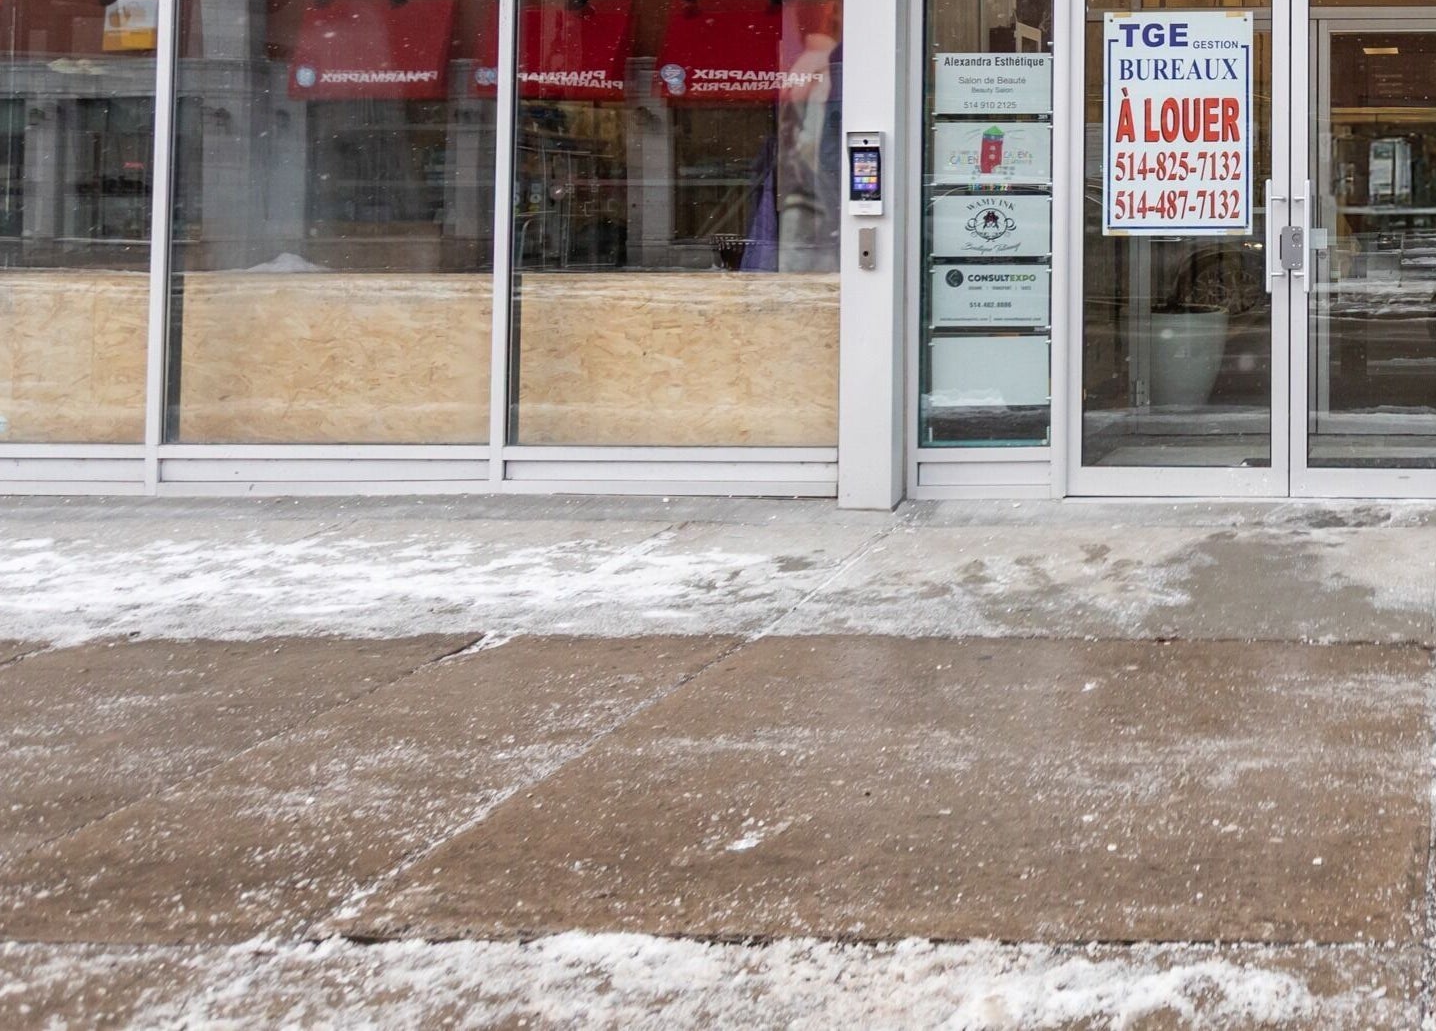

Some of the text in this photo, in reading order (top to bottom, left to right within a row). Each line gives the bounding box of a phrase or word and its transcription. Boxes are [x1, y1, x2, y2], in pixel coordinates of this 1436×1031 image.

[1119, 23, 1239, 49] TGE GESTION
[944, 56, 1044, 68] Alexandra Esthétique
[1119, 58, 1238, 81] BUREAUX
[958, 76, 1026, 84] Salon de Beauté
[963, 101, 1018, 109] 514 910 2125
[1115, 87, 1241, 143] À LOUER
[1115, 151, 1241, 181] 514-825-7132
[966, 198, 1015, 211] WAMY INK
[1115, 190, 1240, 219] 514-487-7132
[967, 274, 1037, 282] CONSULTEXPO
